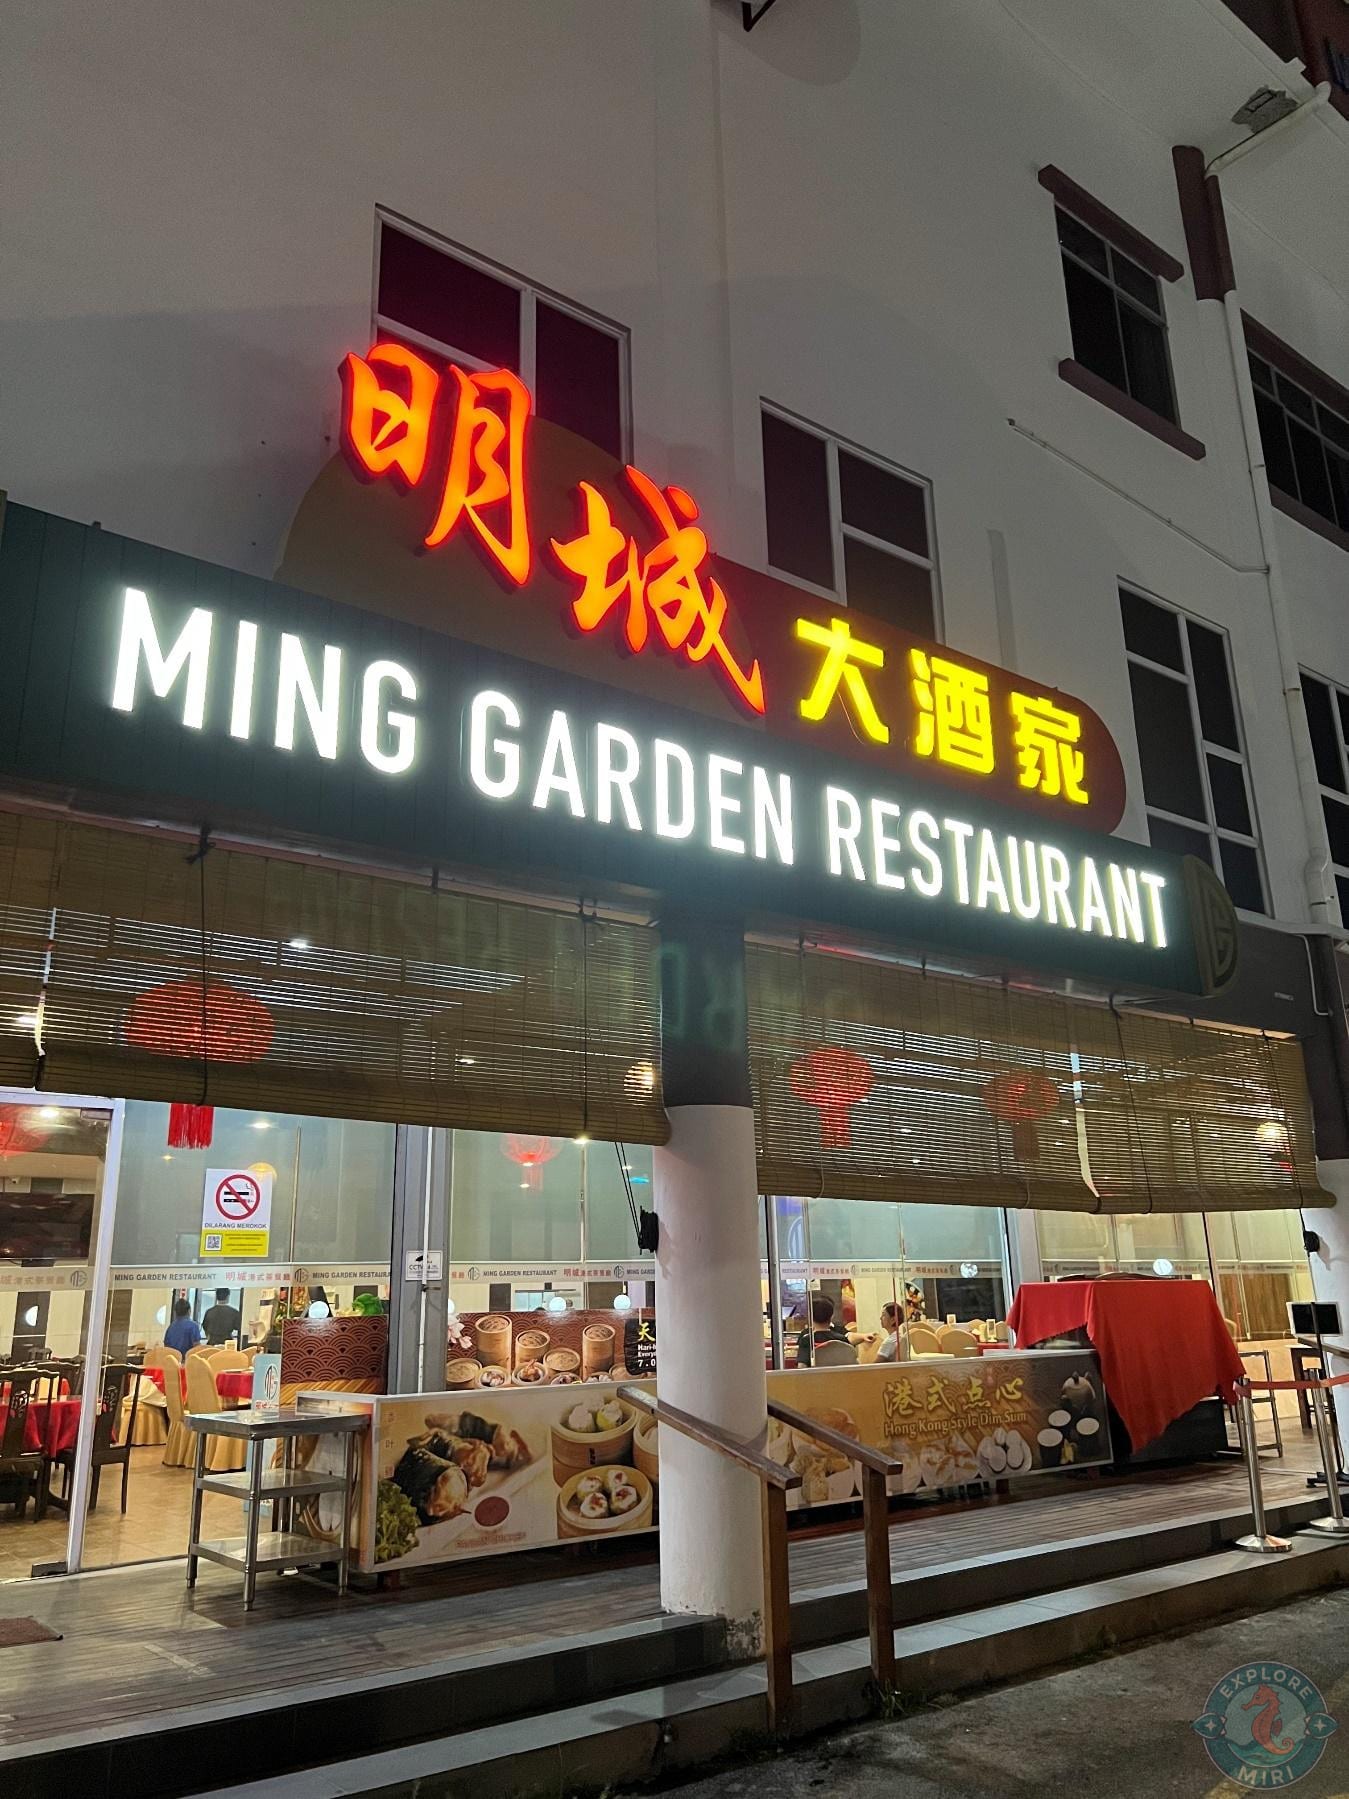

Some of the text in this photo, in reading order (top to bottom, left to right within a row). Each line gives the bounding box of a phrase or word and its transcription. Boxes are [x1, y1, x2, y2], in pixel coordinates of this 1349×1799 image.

[345, 343, 1090, 805] 明城 大酒家
[111, 586, 1168, 949] MING GARDEN RESTAURANT
[883, 1375, 1025, 1418] 港式点心
[884, 1409, 1027, 1439] Hong Kong Style Dim Sum
